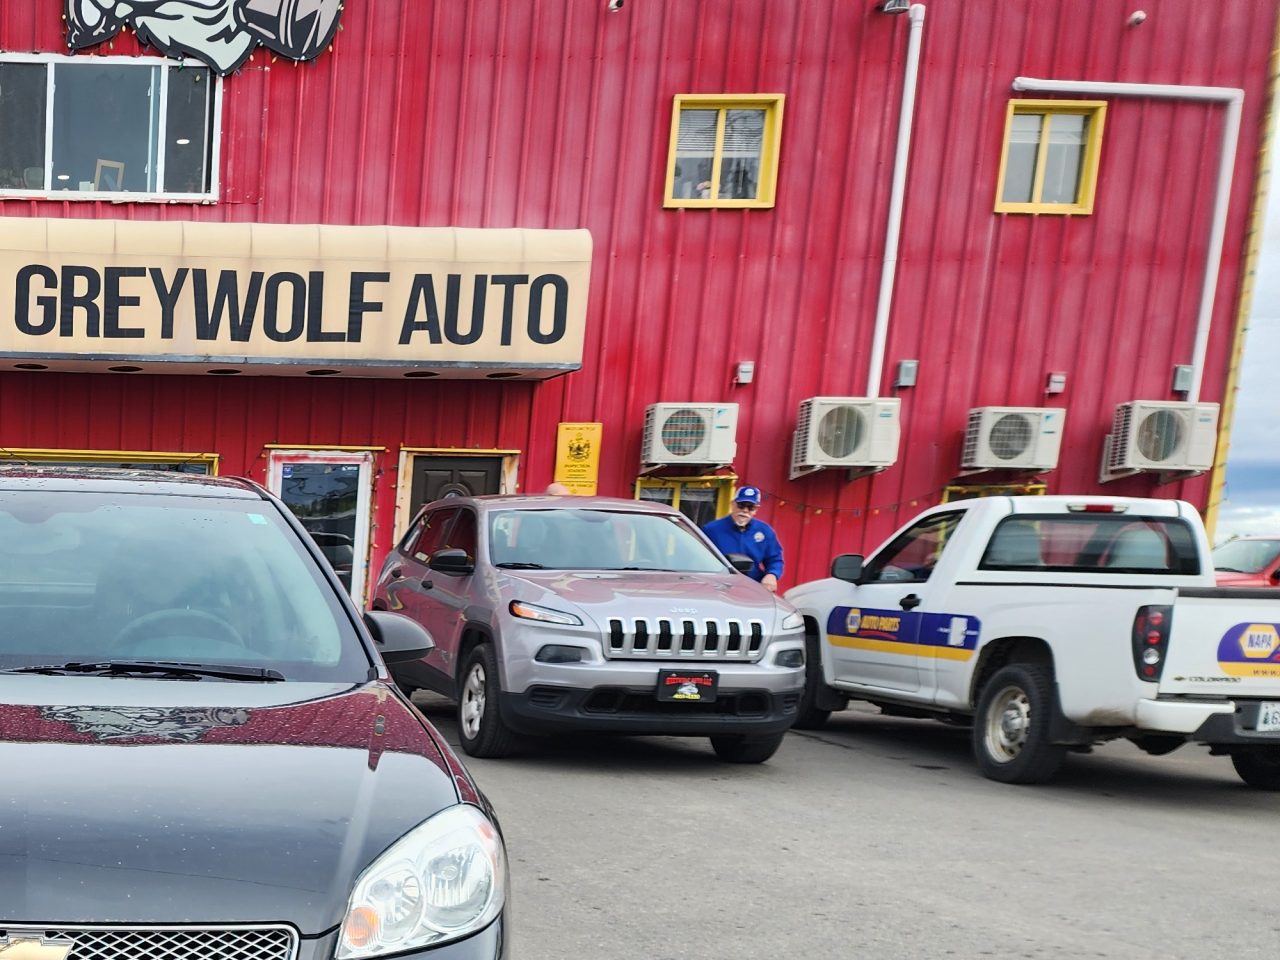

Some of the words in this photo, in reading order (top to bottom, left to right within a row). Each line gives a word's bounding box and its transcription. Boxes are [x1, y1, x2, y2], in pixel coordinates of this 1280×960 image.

[14, 264, 391, 343] GREYWOLF
[398, 273, 570, 347] AUTO
[1248, 633, 1272, 648] NAPA
